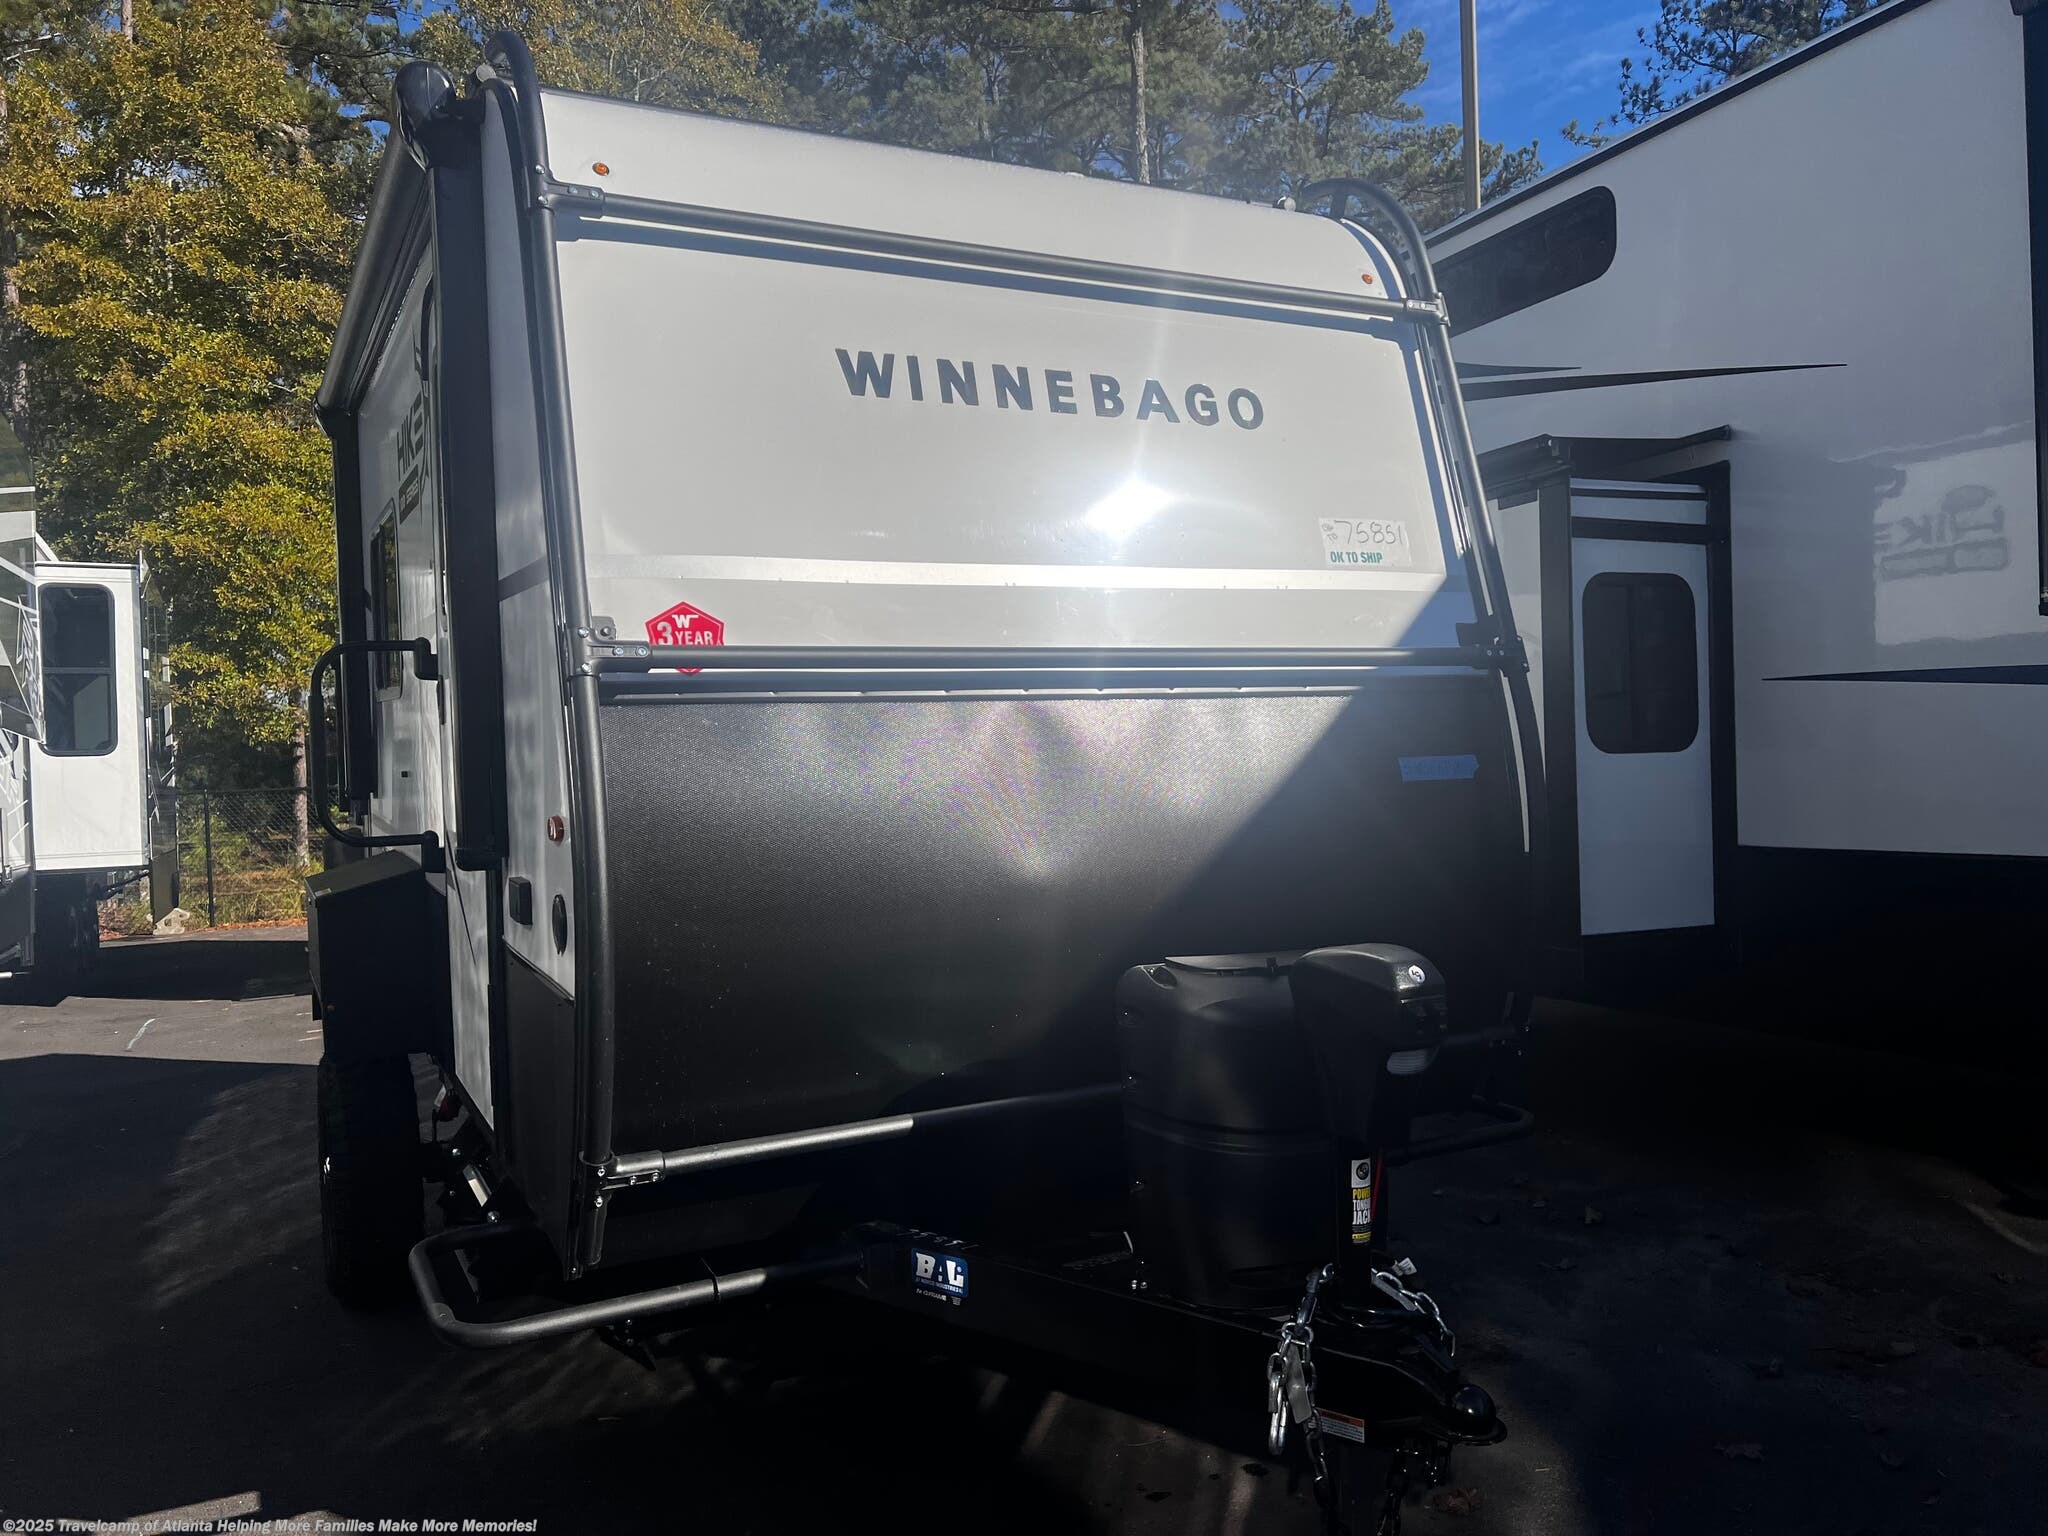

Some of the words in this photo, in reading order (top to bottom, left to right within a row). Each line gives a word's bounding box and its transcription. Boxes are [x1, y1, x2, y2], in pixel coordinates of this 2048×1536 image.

[835, 347, 1264, 431] WINNEBAGO
[1330, 551, 1345, 562] OK
[1346, 551, 1358, 562] TO
[1361, 552, 1382, 563] SHIP
[657, 621, 673, 645] 3
[675, 631, 714, 645] YEAR
